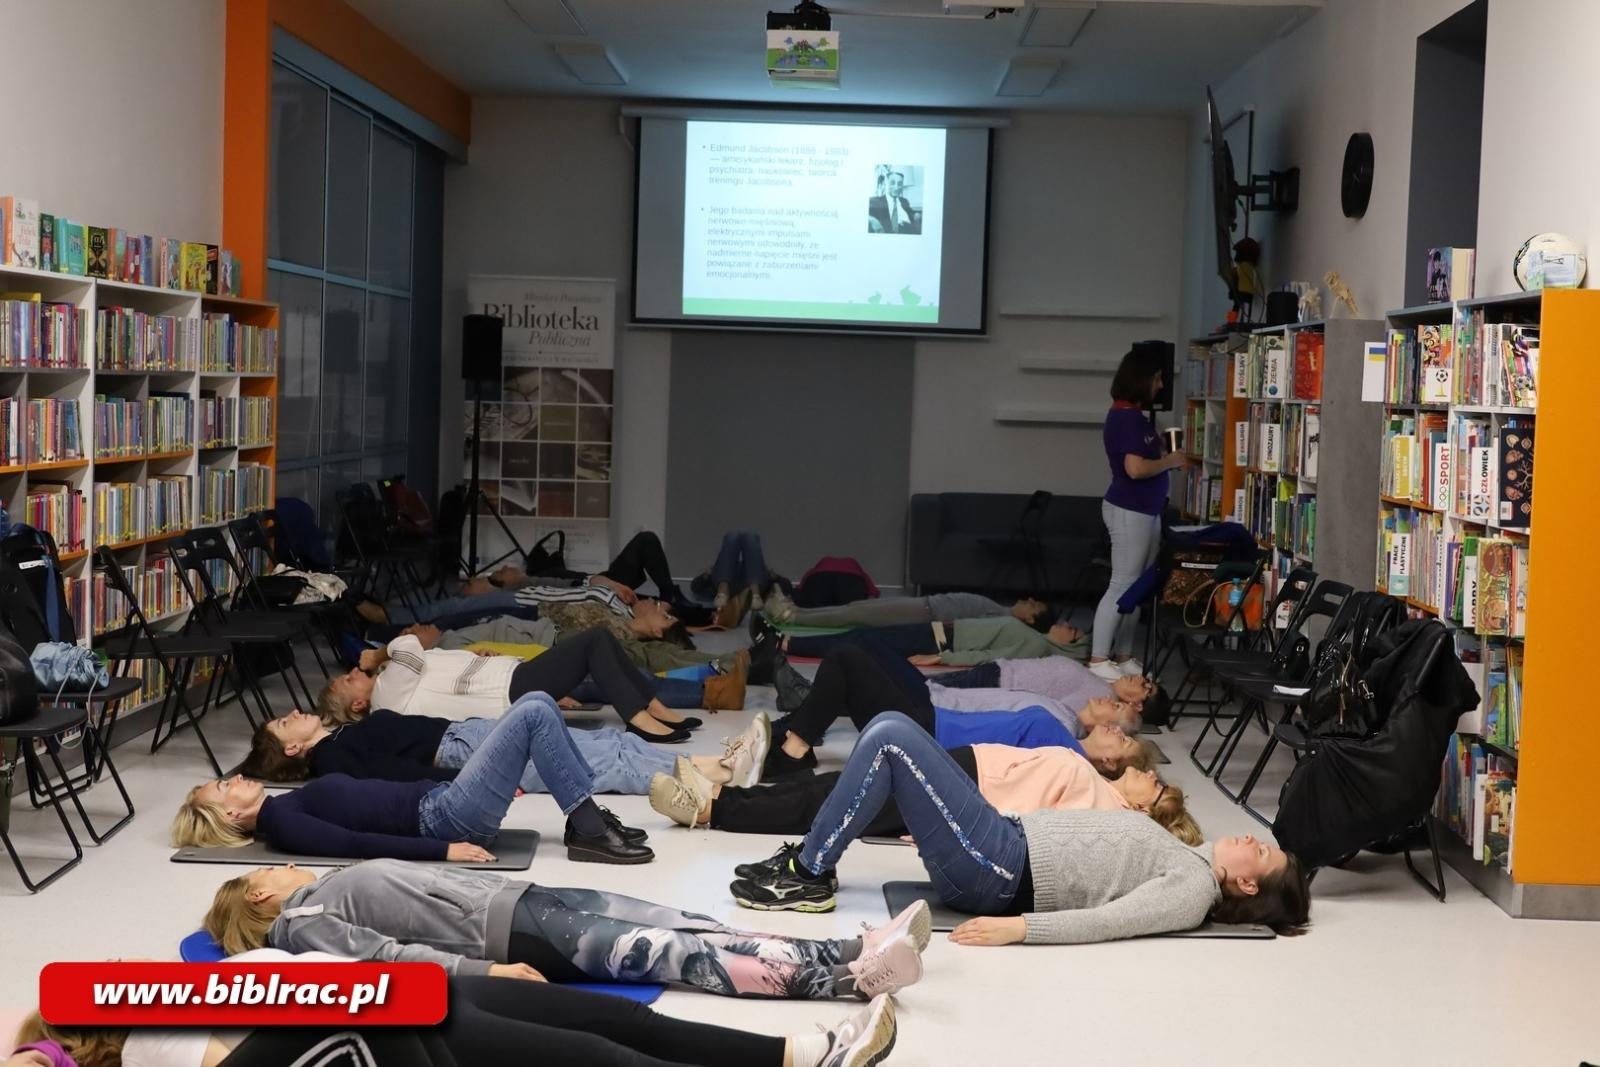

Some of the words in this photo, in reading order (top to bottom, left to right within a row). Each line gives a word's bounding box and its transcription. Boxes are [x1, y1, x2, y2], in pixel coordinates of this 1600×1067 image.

[710, 144, 746, 153] Edmund
[709, 176, 744, 187] treningu
[710, 206, 729, 216] Jego
[767, 207, 784, 215] nad
[528, 330, 591, 347] Publiczna
[1270, 358, 1278, 384] ZIEMIA
[1440, 446, 1449, 486] SPORT
[1481, 449, 1489, 494] CZŁOWIEK
